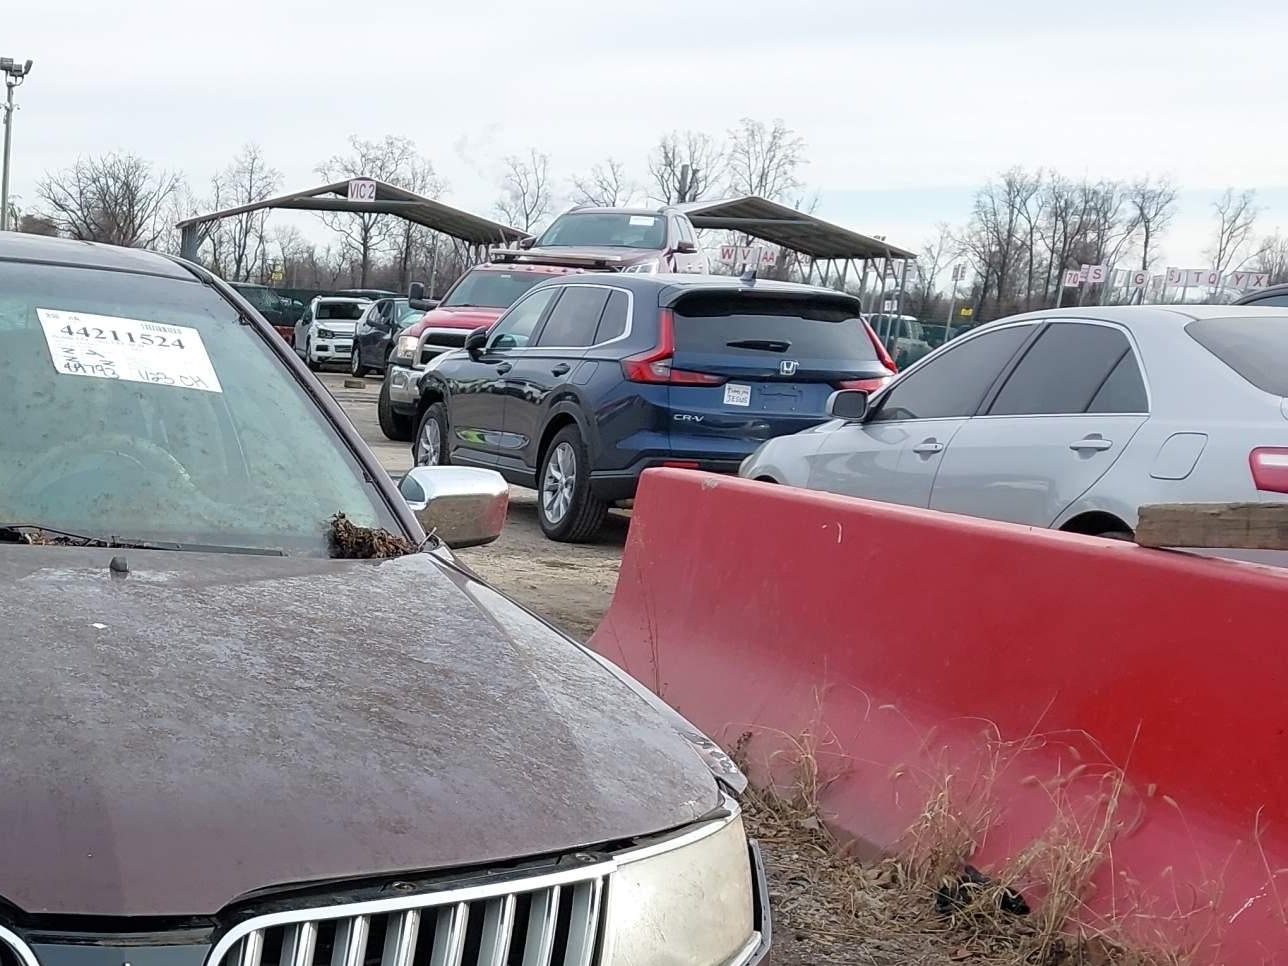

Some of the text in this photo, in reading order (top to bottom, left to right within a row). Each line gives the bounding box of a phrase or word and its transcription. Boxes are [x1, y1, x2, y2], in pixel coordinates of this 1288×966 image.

[349, 183, 375, 199] VIC 2
[721, 248, 734, 259] W
[742, 249, 751, 260] V
[1092, 268, 1102, 280] S
[1134, 273, 1145, 284] G
[1194, 271, 1203, 283] T
[1235, 274, 1245, 286] Y
[1253, 275, 1264, 287] X
[59, 324, 185, 350] 44211524
[673, 414, 705, 422] CR-V
